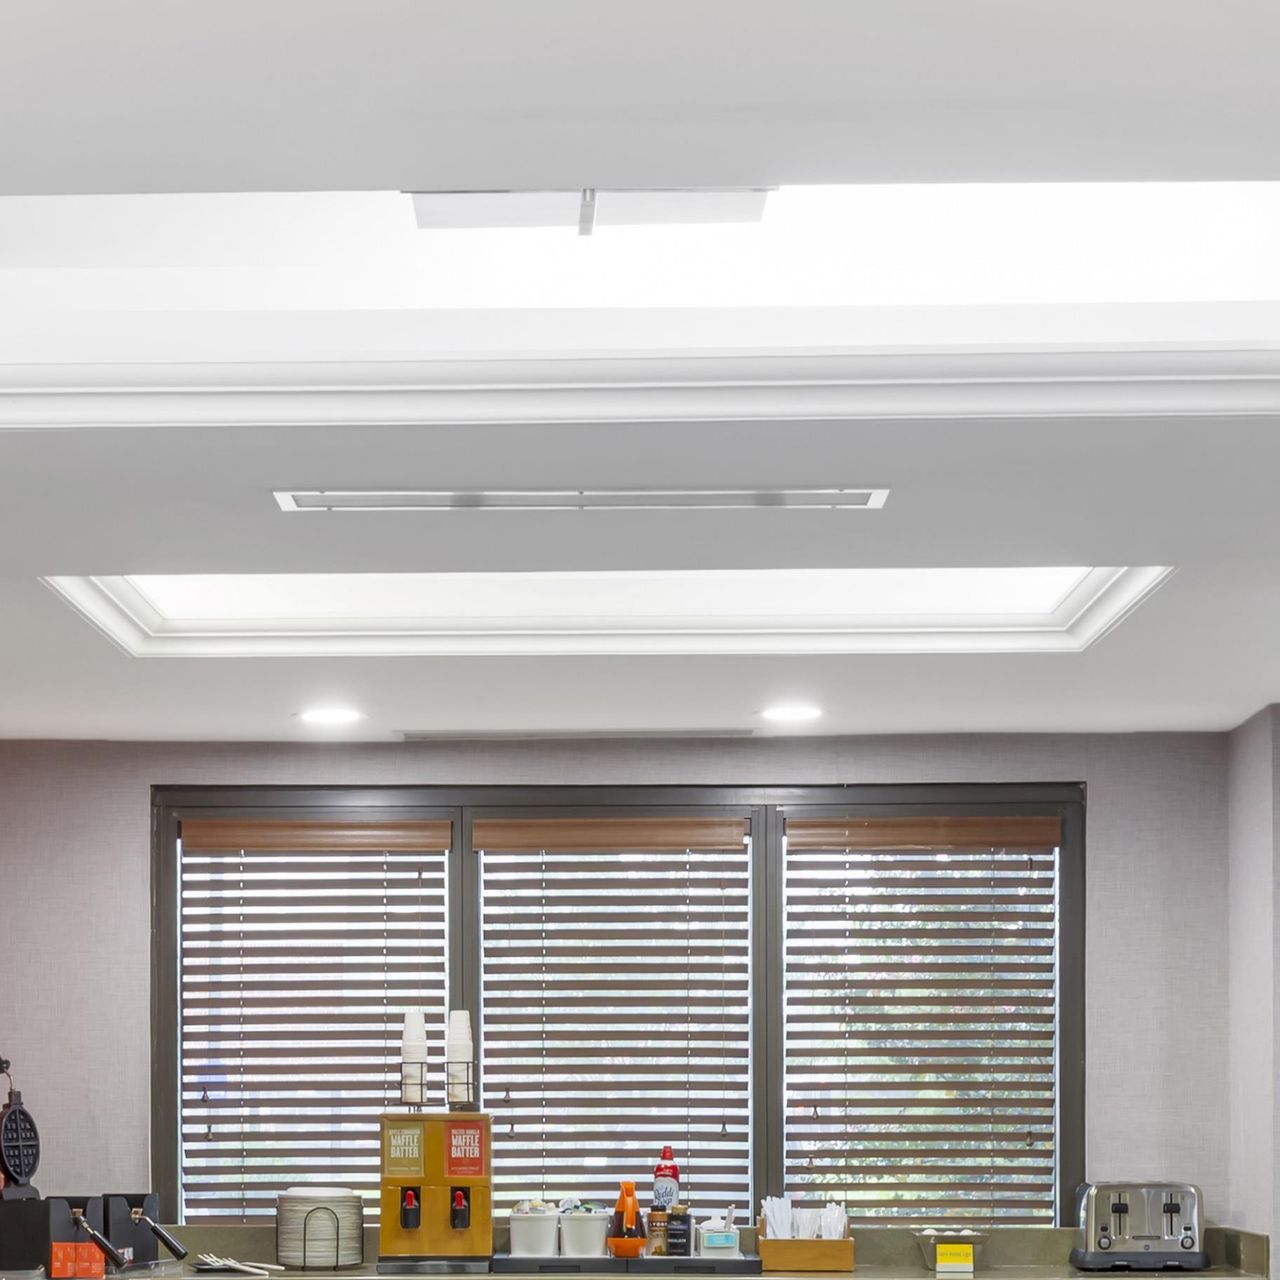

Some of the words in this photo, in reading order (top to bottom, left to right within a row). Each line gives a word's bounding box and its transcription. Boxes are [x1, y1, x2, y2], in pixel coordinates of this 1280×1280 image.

[390, 1134, 419, 1146] WAFFLE
[451, 1134, 480, 1146] WAFFLE
[390, 1146, 419, 1158] BATTER
[451, 1146, 480, 1158] BATTER
